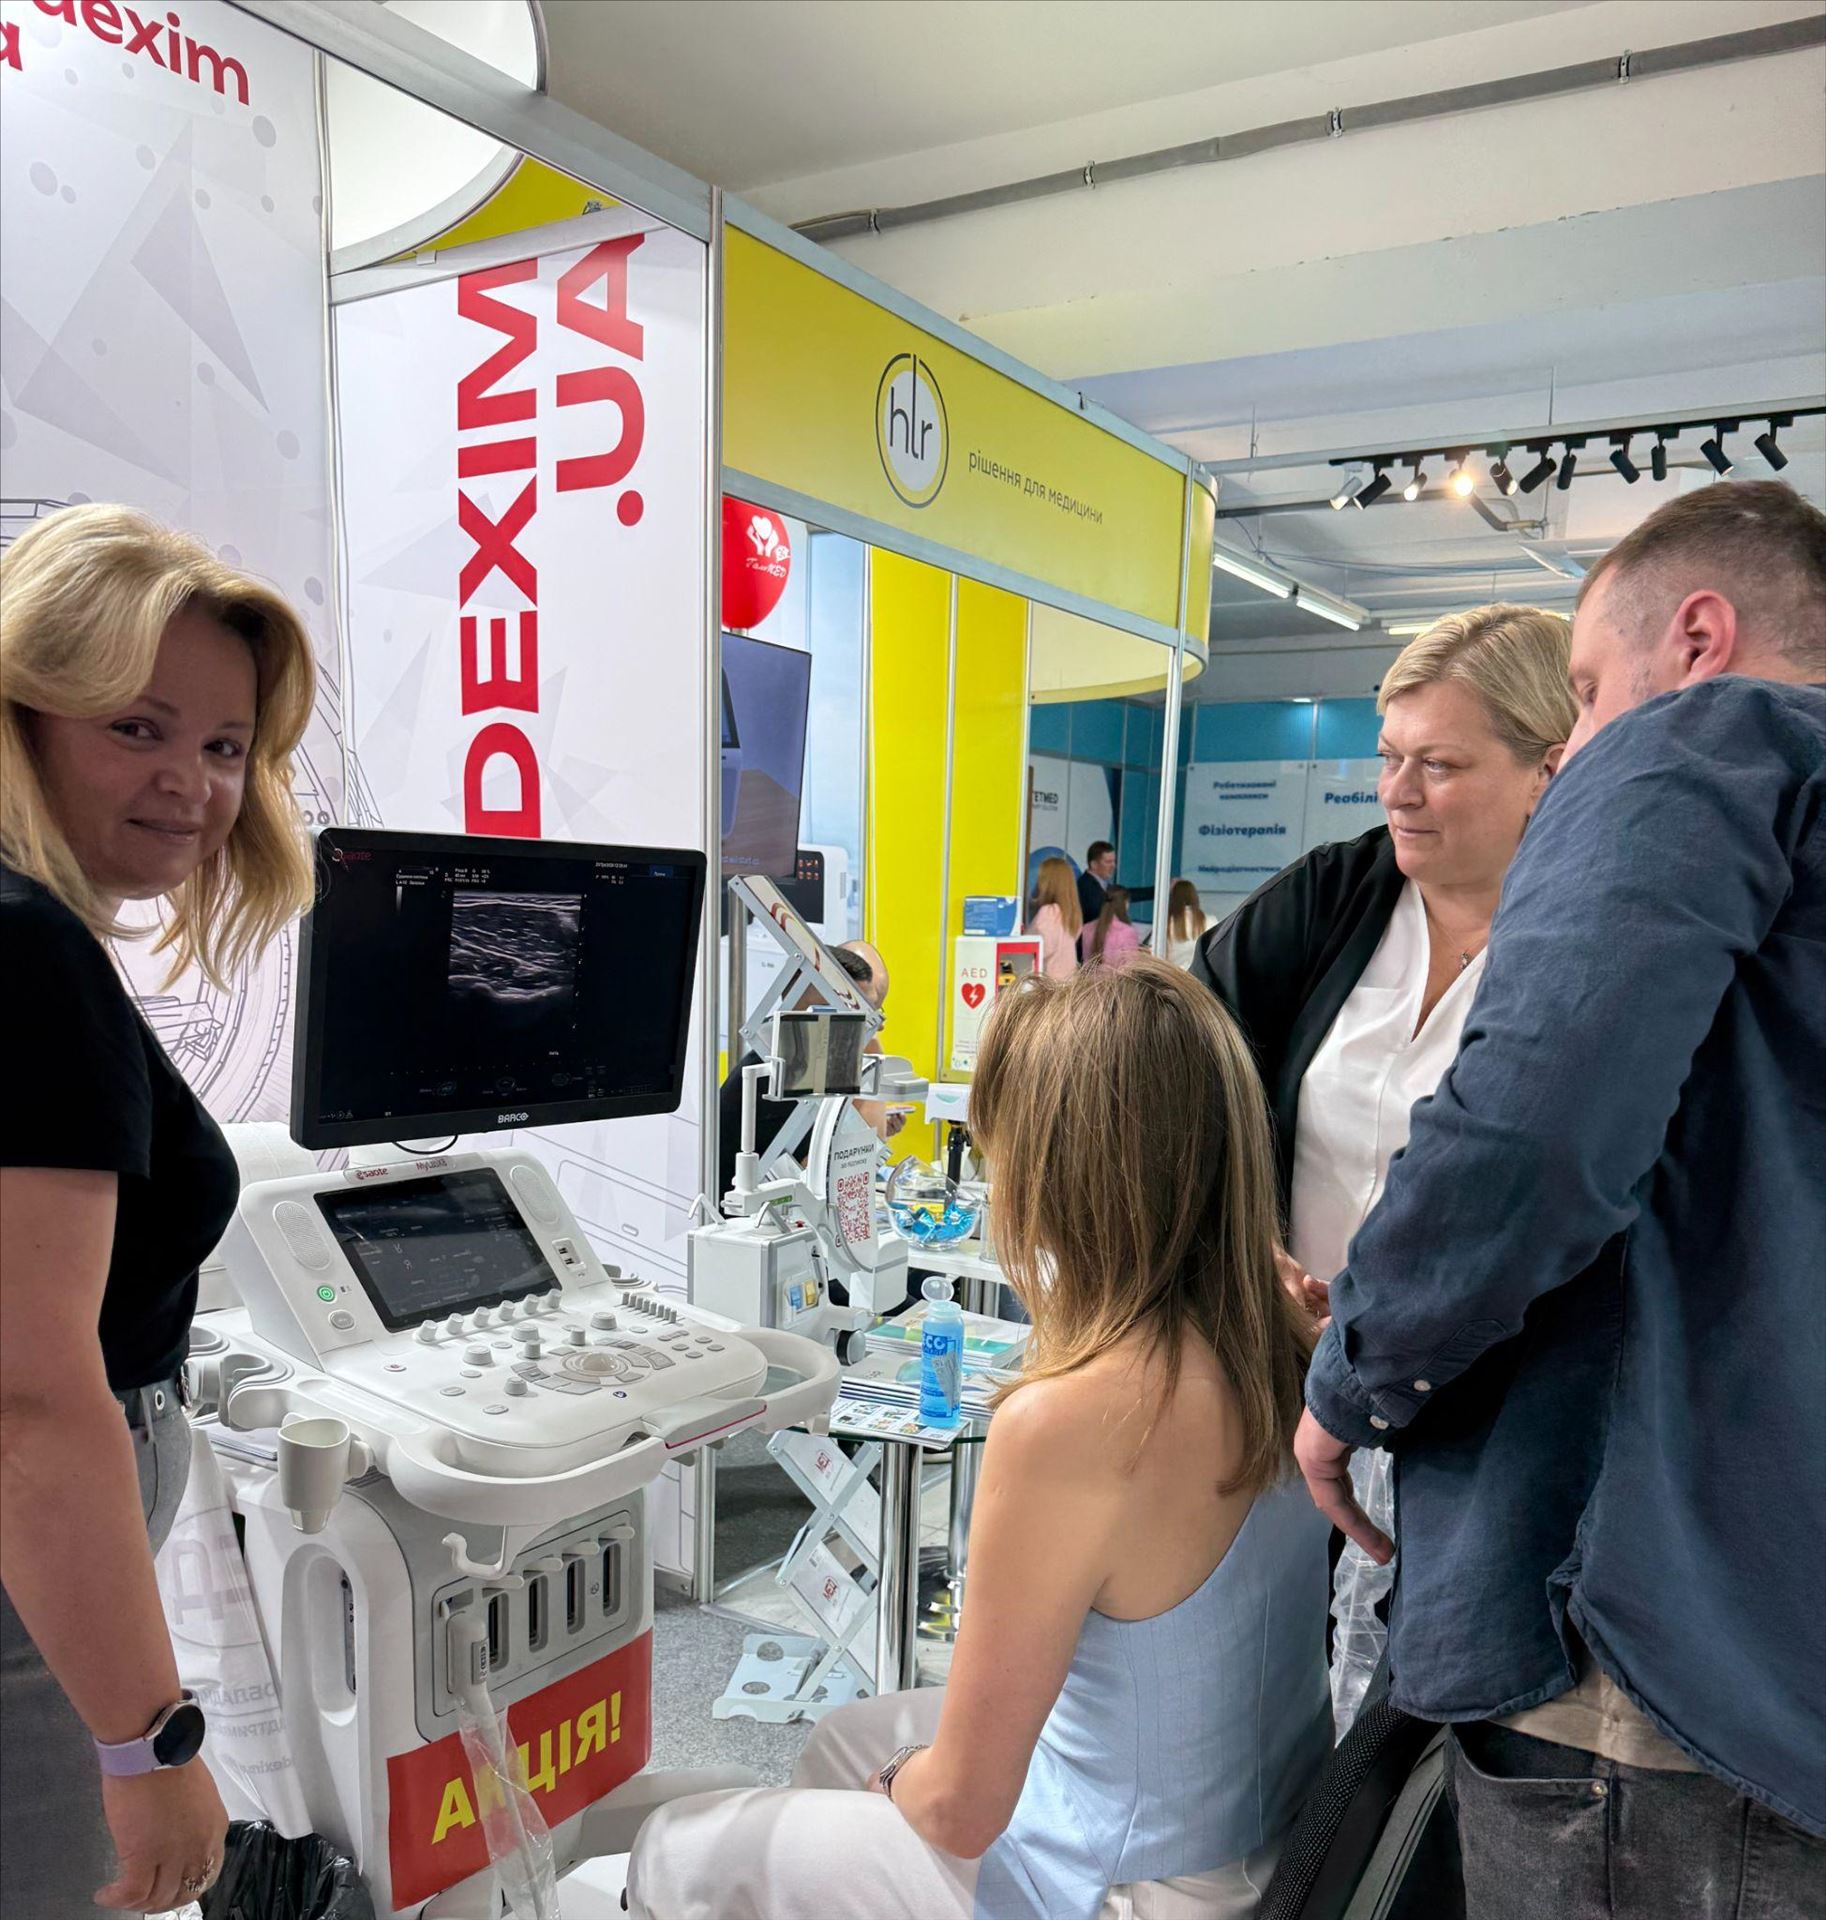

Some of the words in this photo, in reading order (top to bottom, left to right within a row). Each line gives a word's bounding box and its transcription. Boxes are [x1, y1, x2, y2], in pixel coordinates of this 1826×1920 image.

[889, 353, 933, 460] hlr
[968, 450, 1022, 488] рішення
[1023, 476, 1046, 499] для
[1048, 487, 1104, 525] медицини
[457, 256, 542, 839] DEXIM
[1198, 821, 1287, 839] Фізіотерапія
[961, 967, 988, 979] AED
